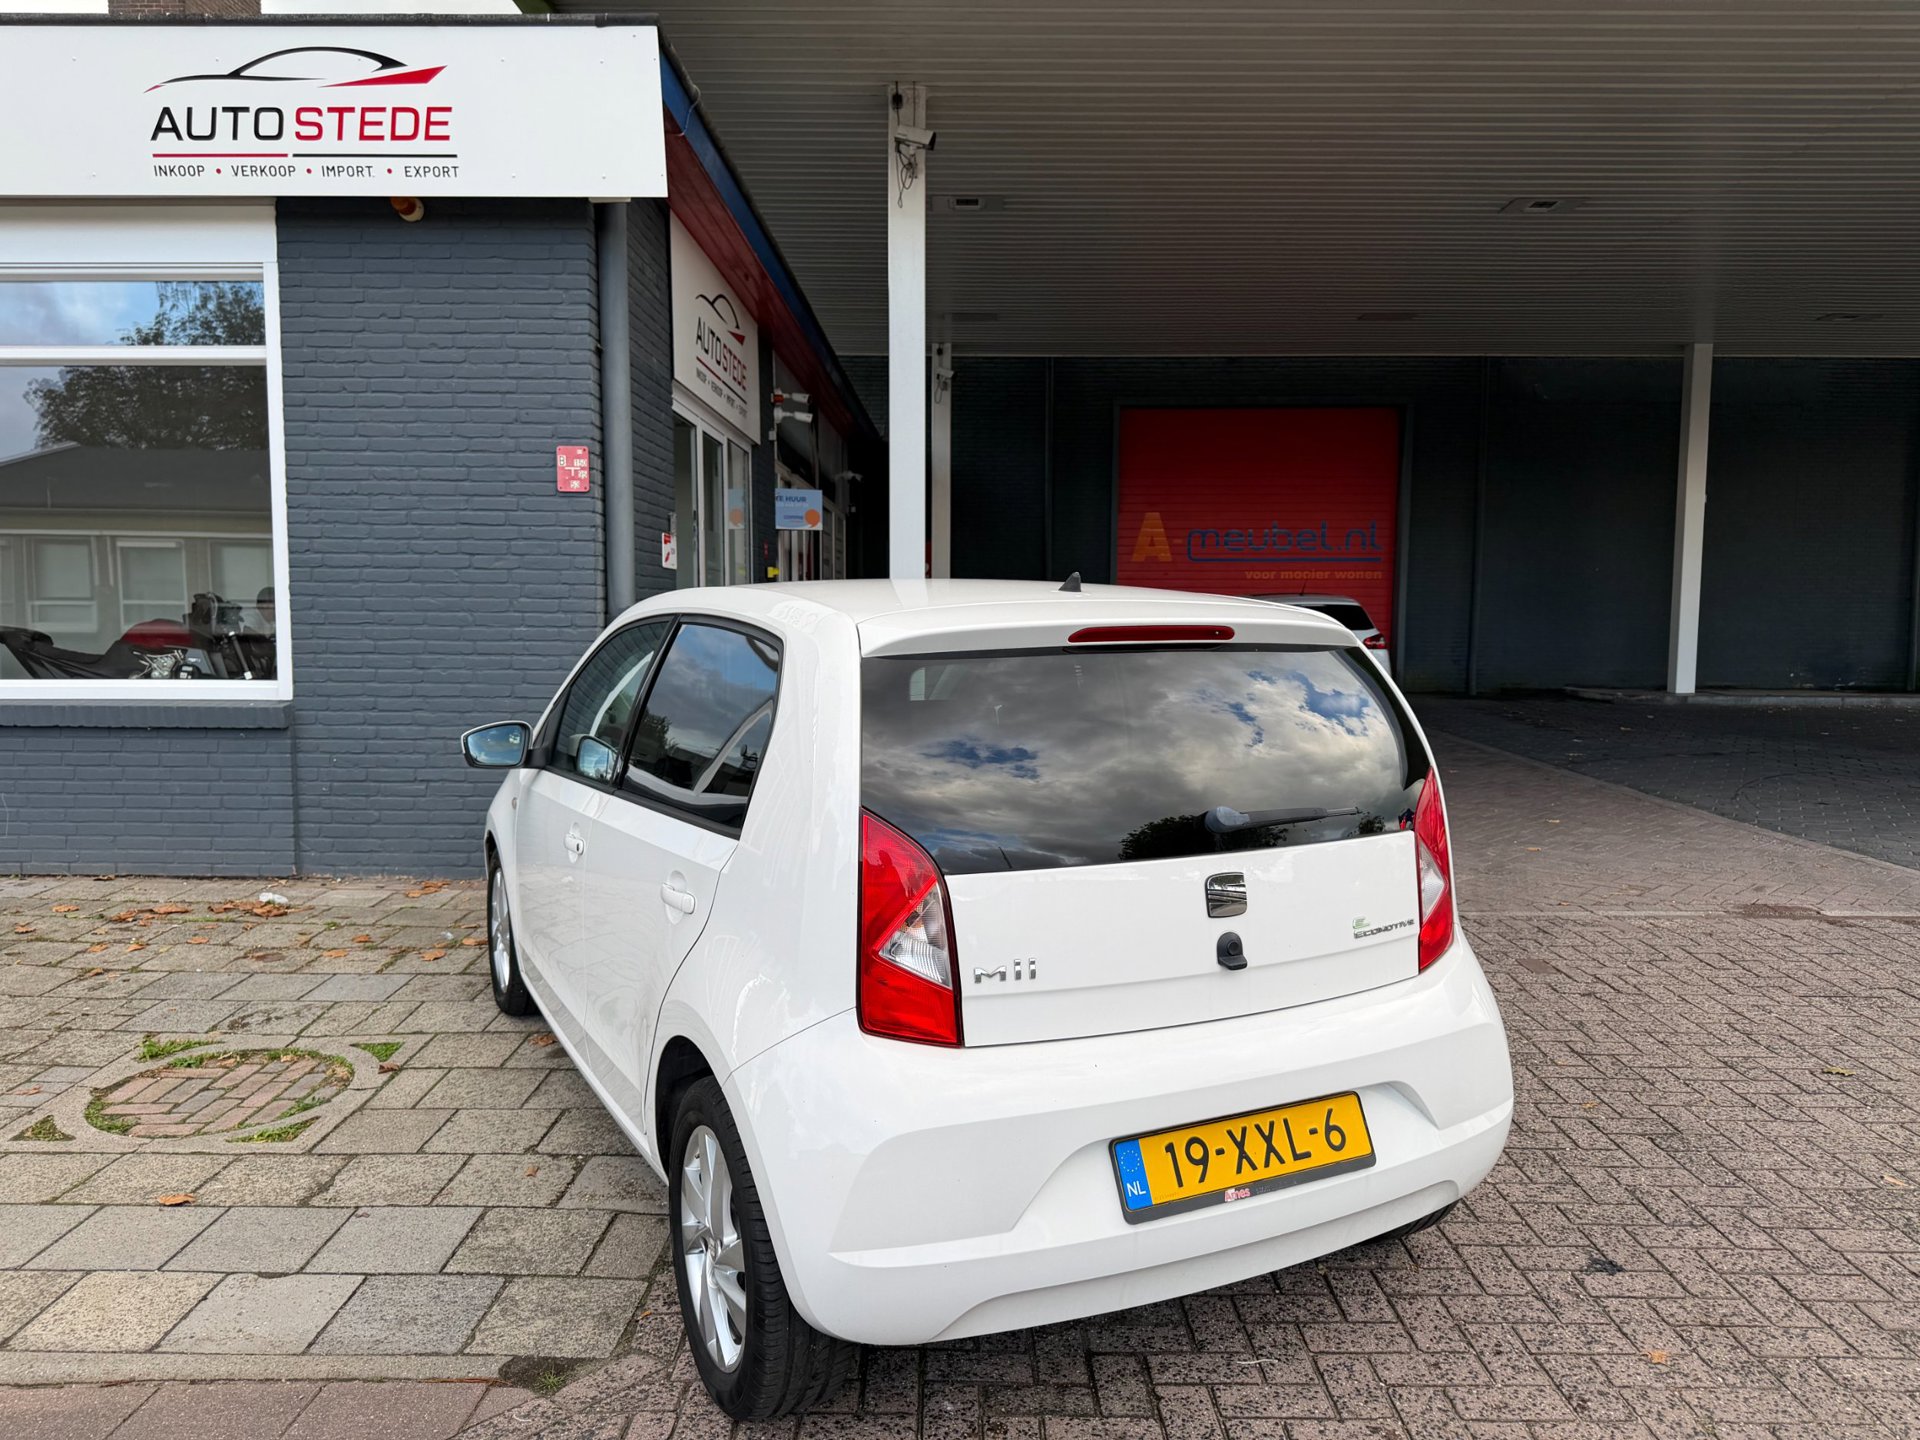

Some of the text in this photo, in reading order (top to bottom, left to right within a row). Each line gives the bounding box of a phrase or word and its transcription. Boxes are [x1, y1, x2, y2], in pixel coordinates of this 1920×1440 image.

[153, 165, 460, 179] INKOOP VERKOOP IMPORT EXPORT
[1244, 568, 1382, 580] voor mooier wonen
[973, 957, 1037, 984] Mii
[1164, 1107, 1348, 1188] 19-XXL-6
[1126, 1180, 1147, 1197] NL
